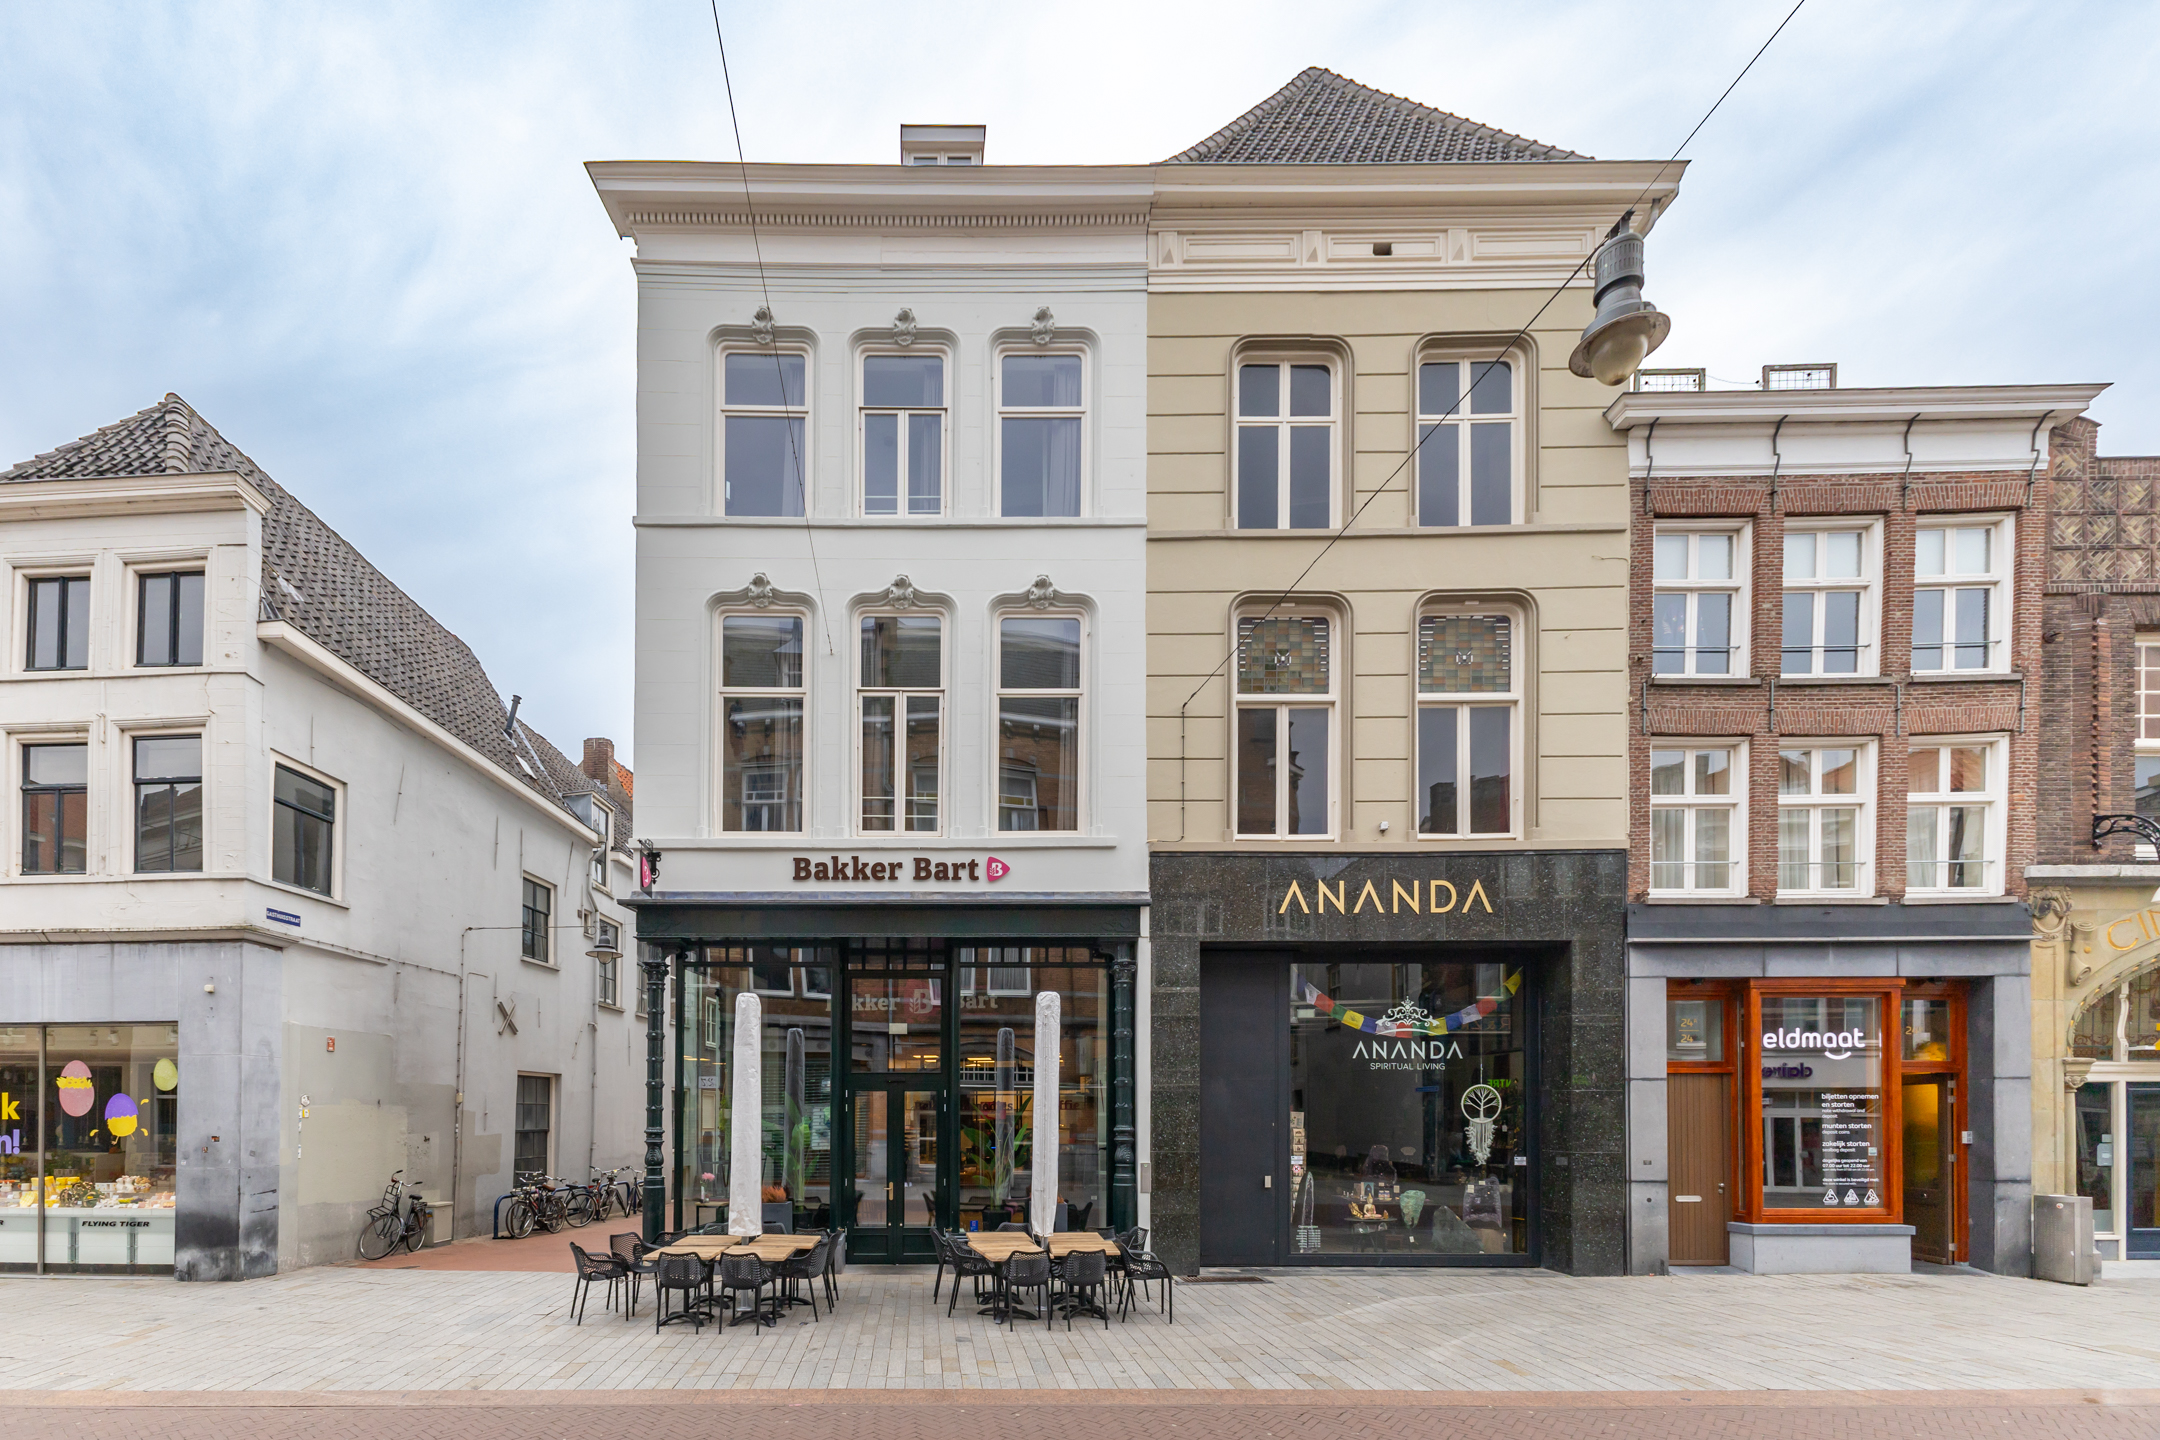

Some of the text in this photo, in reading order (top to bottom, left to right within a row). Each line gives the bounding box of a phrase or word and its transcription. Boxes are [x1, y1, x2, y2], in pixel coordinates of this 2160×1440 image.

[792, 856, 979, 881] Bakker Bart
[1278, 878, 1494, 915] ANANDA
[960, 993, 999, 1009] art
[1680, 1034, 1694, 1043] 24
[1352, 1040, 1464, 1060] ANANDA
[1369, 1062, 1446, 1071] SPIRITUAL LIVING
[1822, 1140, 1846, 1148] zakelijk
[119, 1220, 150, 1228] TIGER
